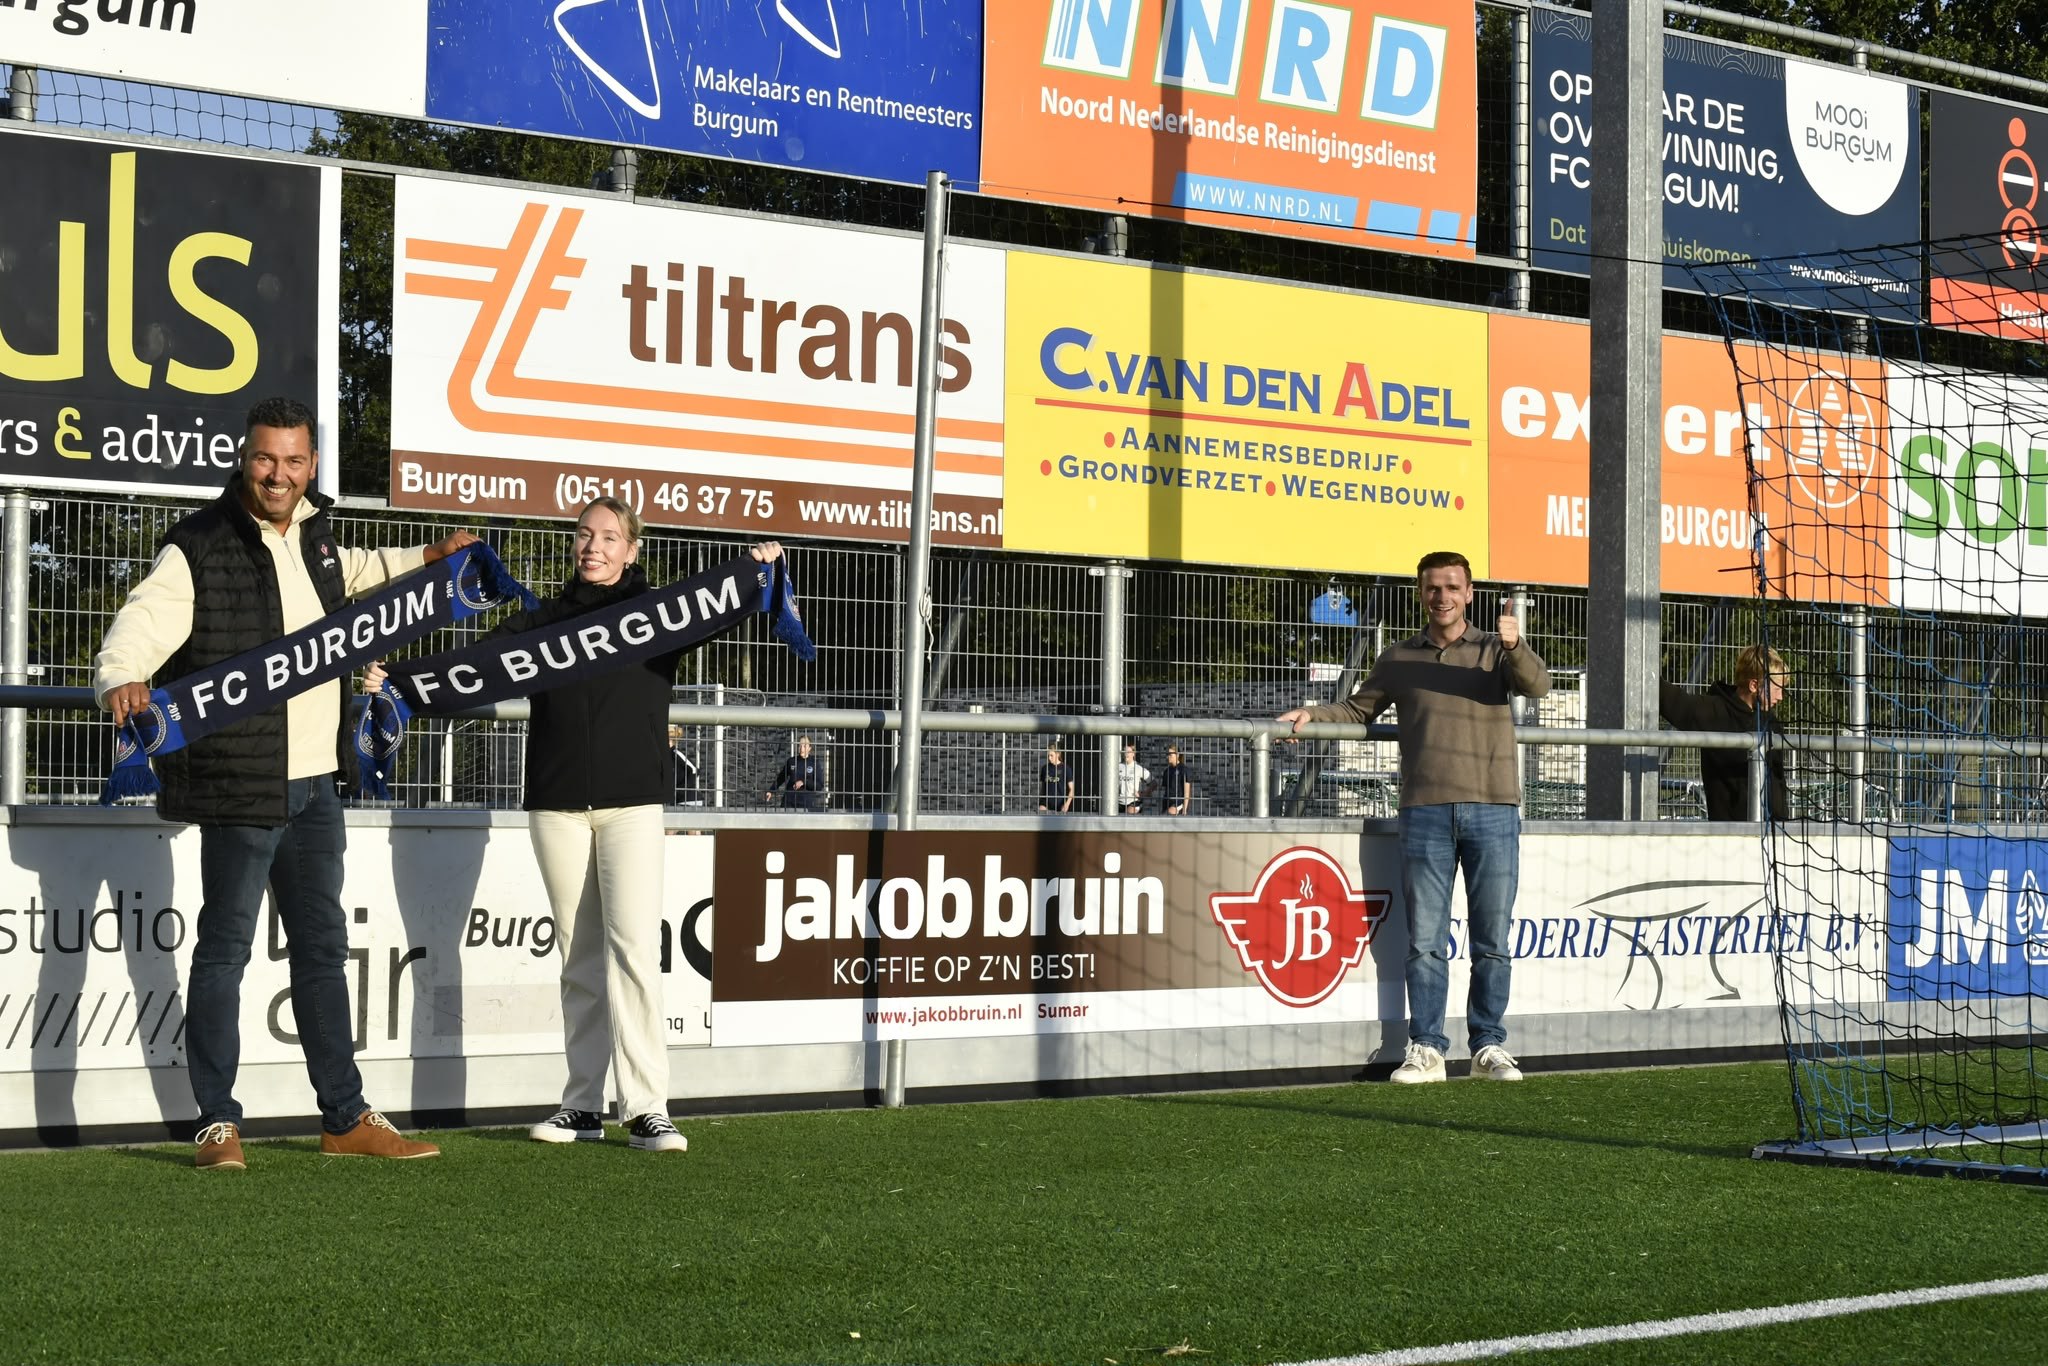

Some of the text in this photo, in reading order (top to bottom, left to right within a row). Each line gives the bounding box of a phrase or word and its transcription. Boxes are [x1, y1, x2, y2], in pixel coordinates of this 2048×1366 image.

[693, 103, 778, 138] Burgum
[694, 65, 973, 130] Makelaars en Rentmeesters
[1041, 86, 1436, 174] Noord Nederlandse Reinigingsdienst
[1550, 69, 1592, 104] OP
[1704, 98, 1744, 135] DE
[1551, 152, 1591, 189] FC
[1806, 127, 1892, 163] BURGUM
[1190, 182, 1343, 223] WWW.NNRD.NL
[1550, 217, 1587, 244] Dat
[622, 261, 972, 394] tiltrans
[1223, 364, 1321, 414] DEN
[1333, 361, 1470, 429] ADEL
[1501, 385, 1771, 461] exert
[1058, 454, 1451, 509] GRONDVERZET WEGENBOUW
[1120, 427, 1400, 473] AANNEMERSBEDRIJF
[401, 462, 1003, 535] Burgum (0511) 46 37 75 www.tiltans.nl
[191, 581, 435, 719] FC BURGUM
[410, 575, 741, 704] FC BURGUM
[0, 889, 186, 955] studio
[465, 907, 557, 958] Burg
[756, 851, 973, 962] jakob
[983, 852, 1164, 938] bruin
[1272, 898, 1332, 970] JB
[1905, 869, 2008, 967] JM
[834, 956, 925, 984] KOFFIE
[934, 955, 970, 982] OP
[1031, 952, 1095, 980] BEST!
[866, 1002, 1089, 1027] www.jakobbruin.nl Sumar
